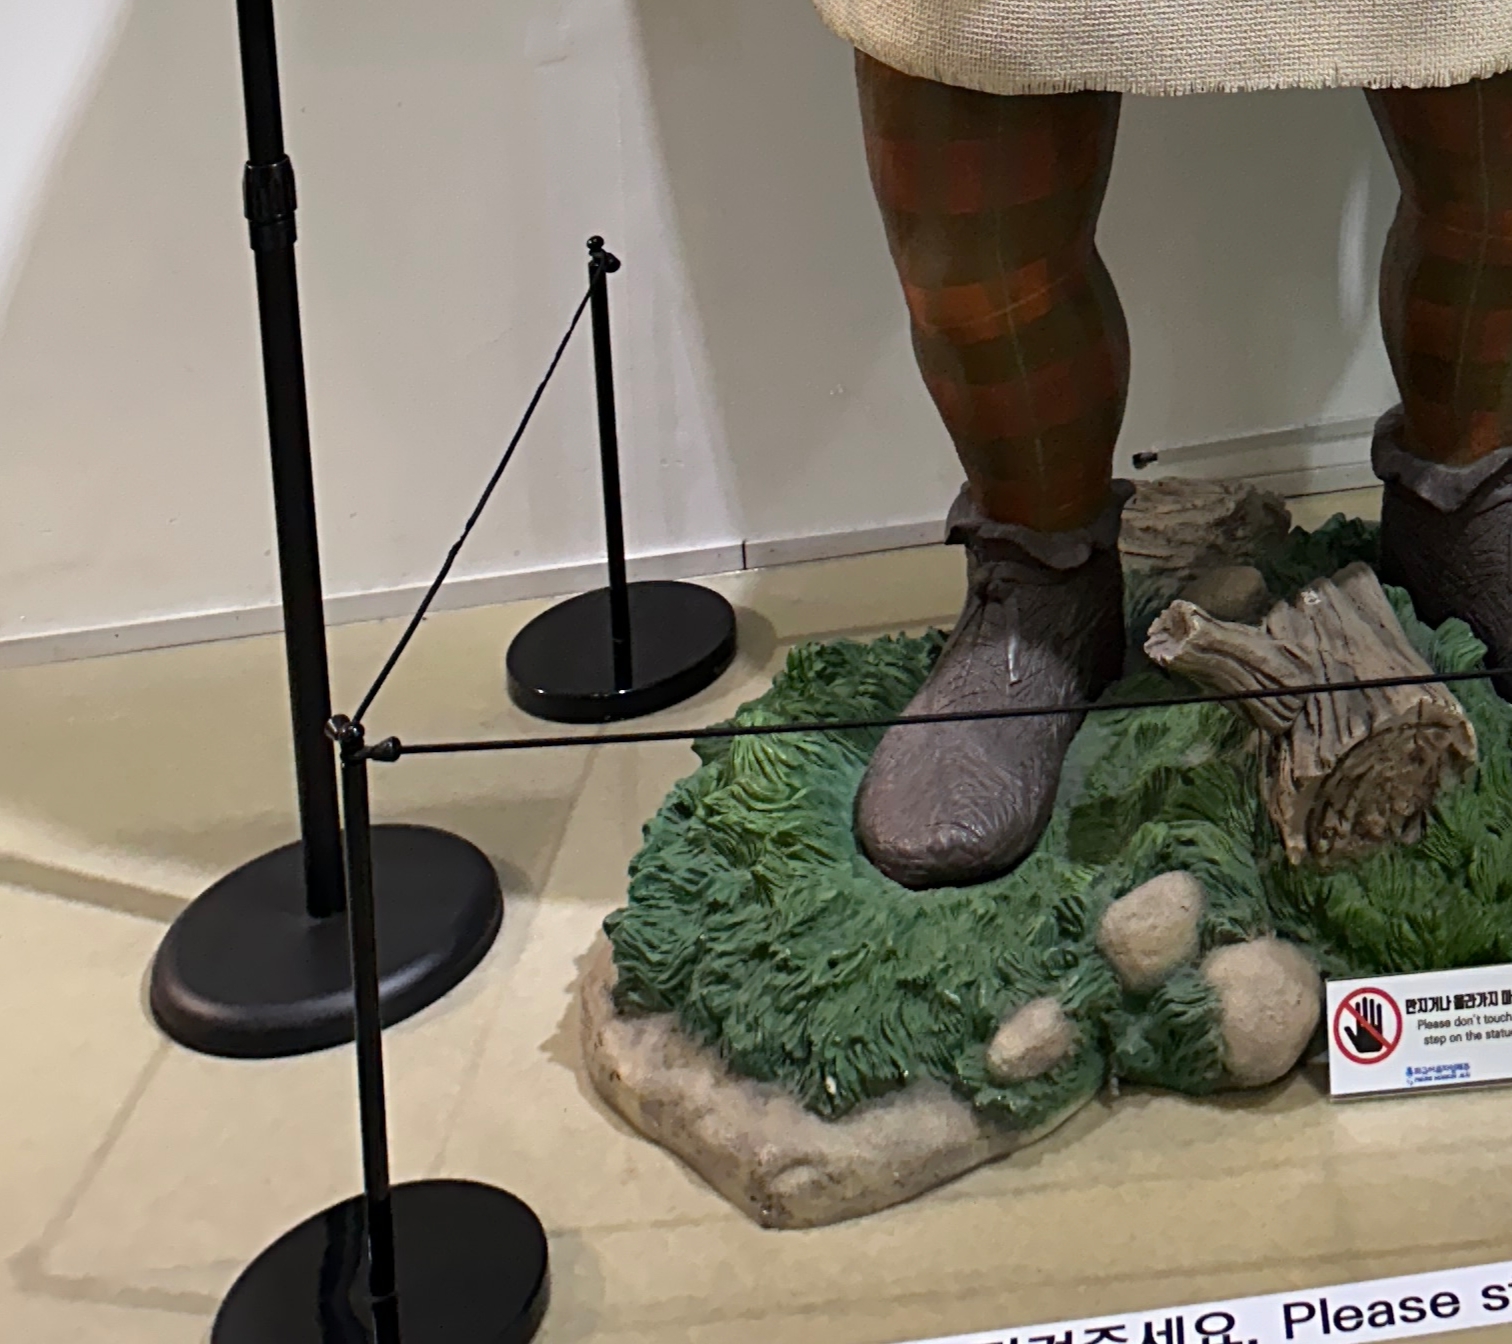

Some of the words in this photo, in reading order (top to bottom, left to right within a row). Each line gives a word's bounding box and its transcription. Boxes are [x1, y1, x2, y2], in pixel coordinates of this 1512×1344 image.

[1405, 996, 1452, 1015] 만지거나
[1417, 1018, 1451, 1031] Please
[1454, 1013, 1481, 1028] don't
[1484, 1012, 1512, 1025] touch
[1423, 1034, 1446, 1047] step
[1449, 1033, 1463, 1043] on
[1465, 1030, 1482, 1041] the
[1283, 1293, 1460, 1339] Please
